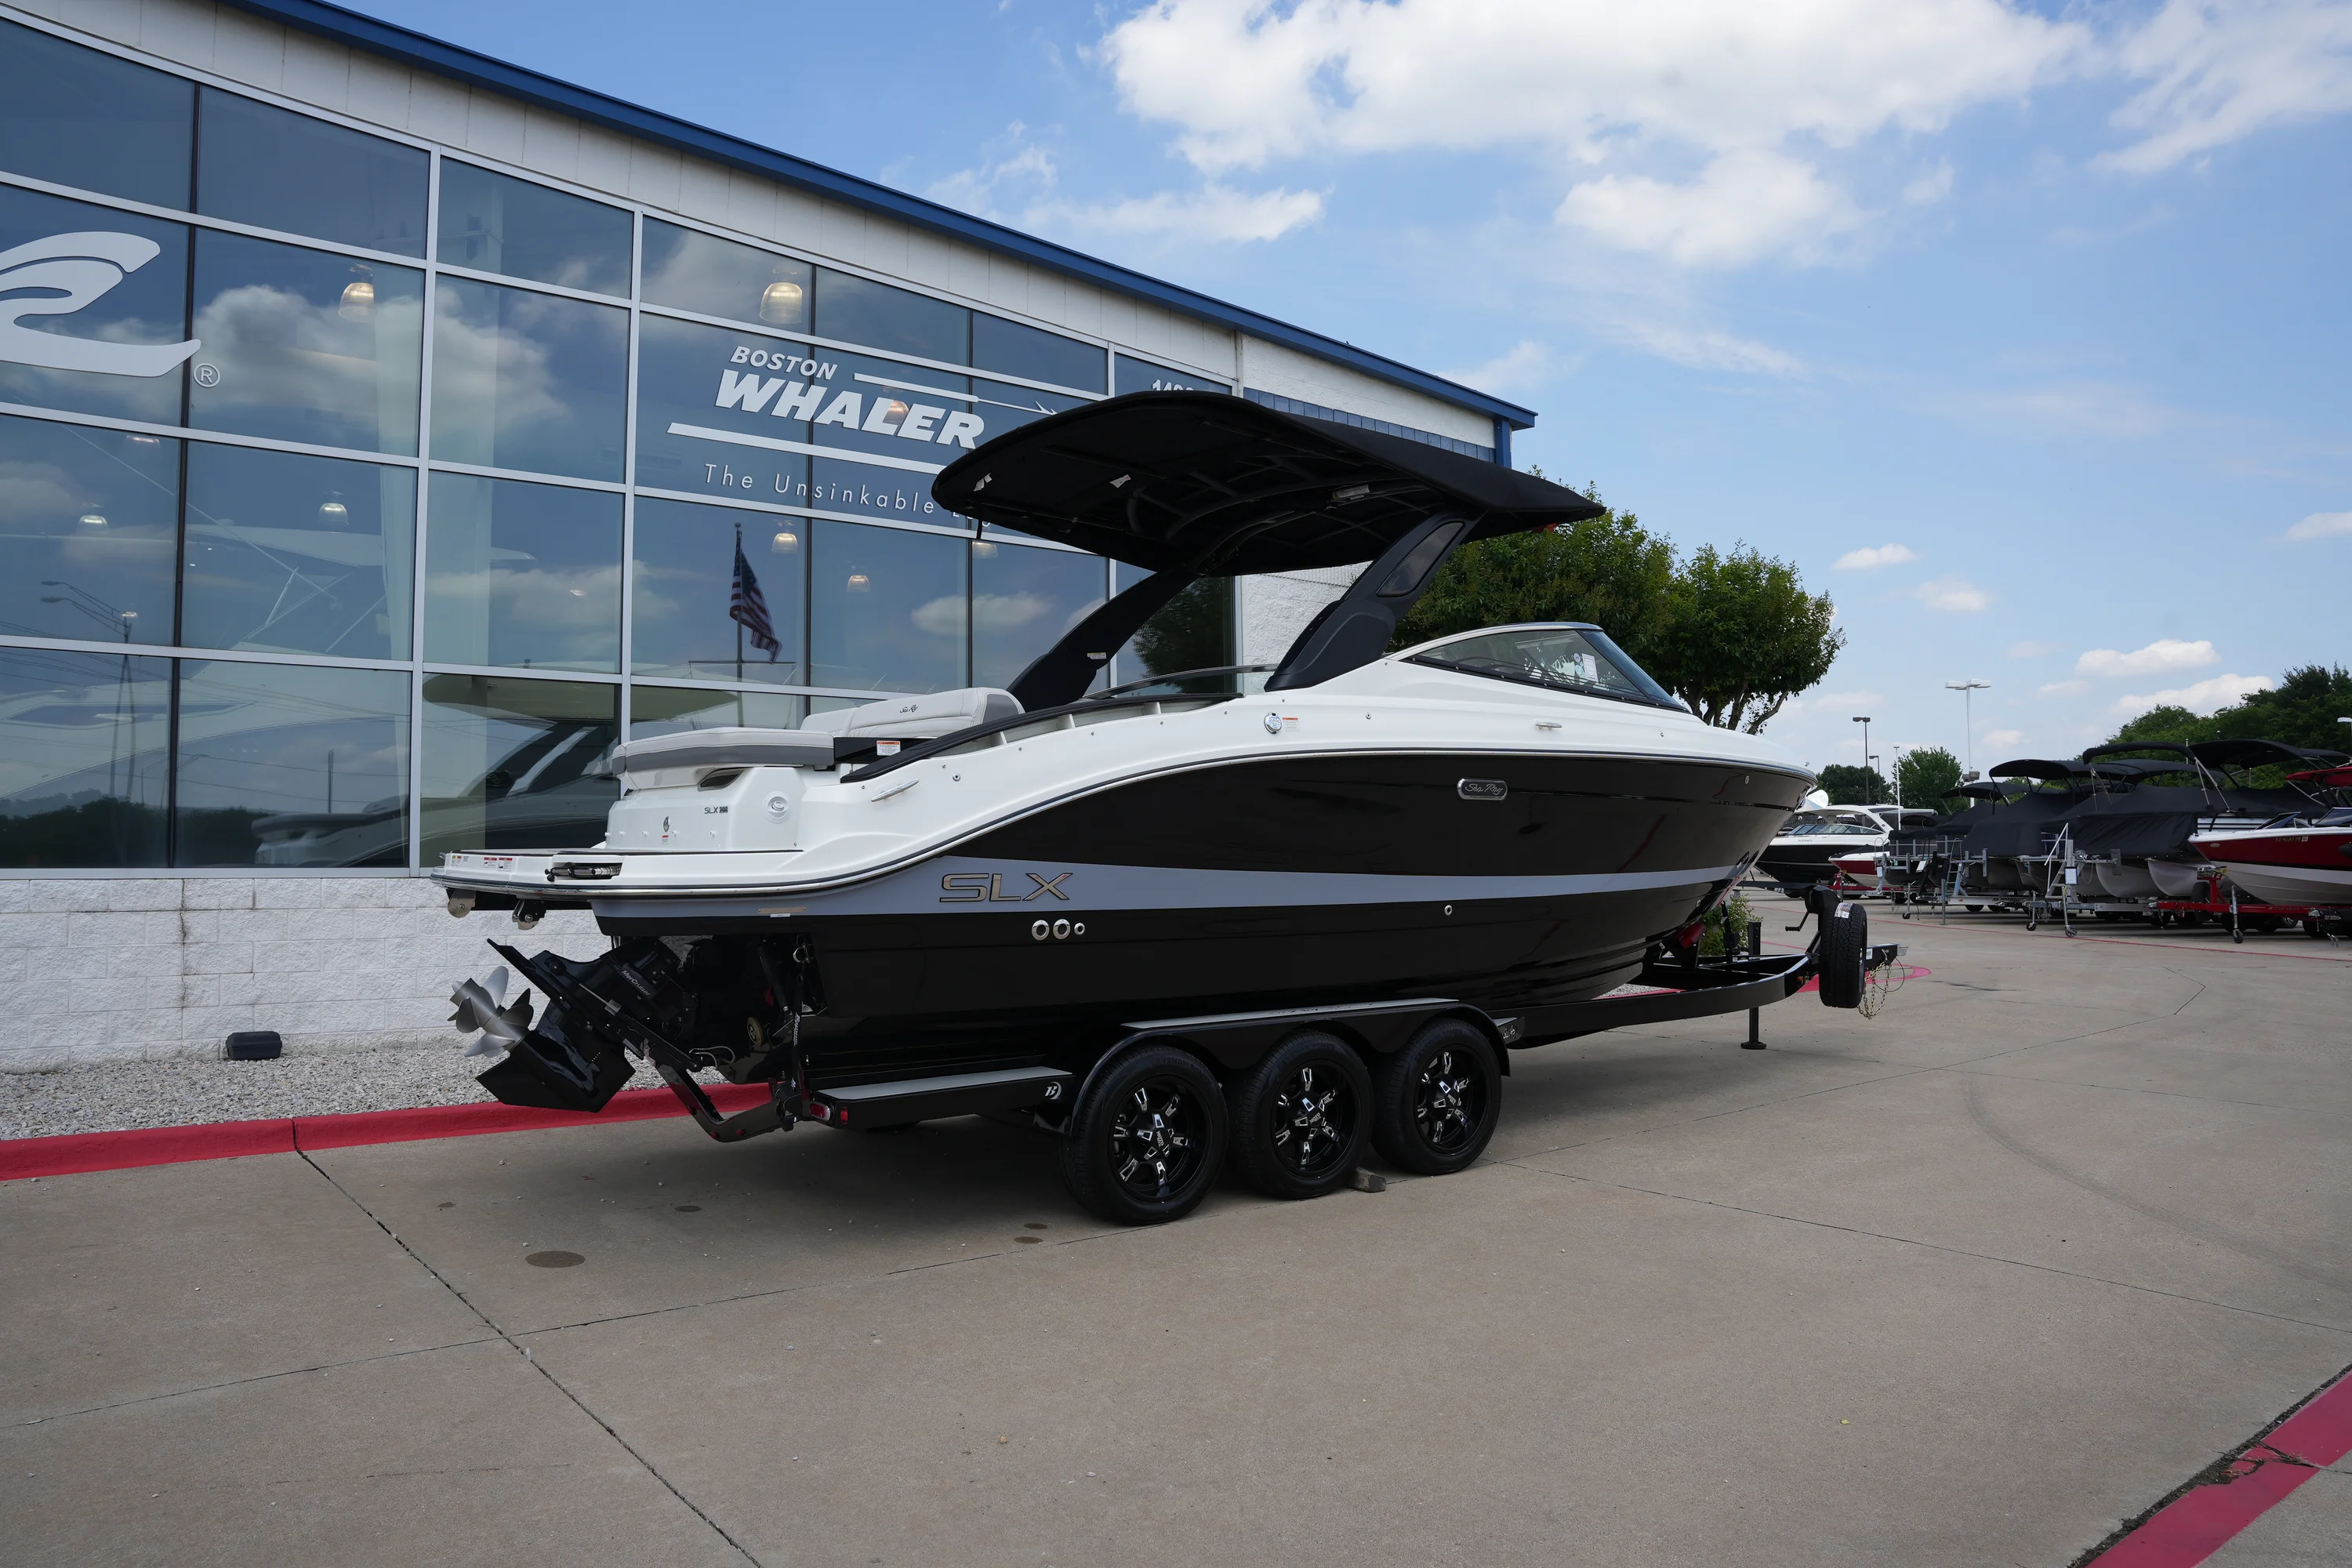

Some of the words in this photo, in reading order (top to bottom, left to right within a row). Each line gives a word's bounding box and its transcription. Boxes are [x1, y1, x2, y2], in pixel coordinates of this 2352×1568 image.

[730, 346, 837, 379] BOSTON
[715, 369, 985, 449] WHALER
[705, 463, 753, 488] The
[775, 473, 934, 514] Unsinkable
[1465, 783, 1483, 792] Sea
[1484, 783, 1504, 796] Ray
[704, 806, 719, 815] SLX
[939, 873, 1073, 902] SLX
[621, 970, 651, 996] MerCruiser
